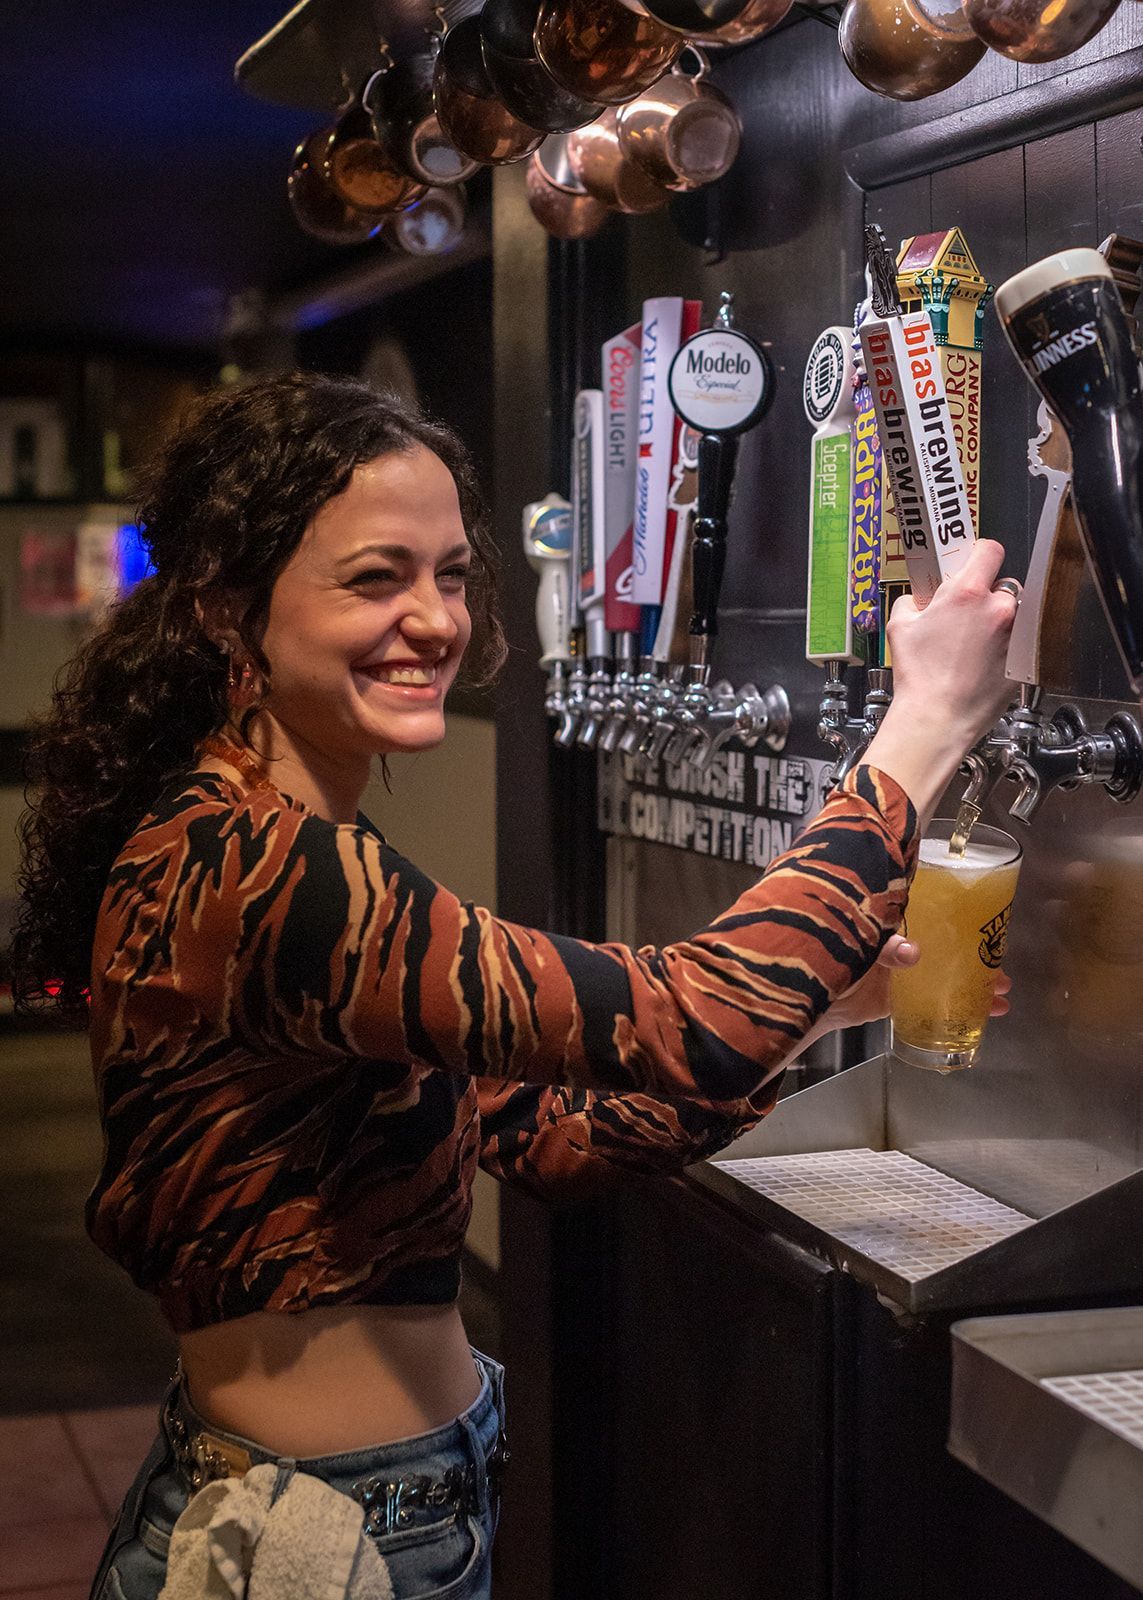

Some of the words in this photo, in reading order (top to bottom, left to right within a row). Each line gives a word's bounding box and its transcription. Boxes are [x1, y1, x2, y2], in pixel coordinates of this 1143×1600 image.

[610, 347, 633, 410] Coors
[640, 318, 658, 435] ULTRA
[686, 349, 751, 375] Modelo
[694, 374, 741, 392] Especial
[830, 335, 844, 380] WORKS
[610, 413, 625, 467] LIGHT
[967, 358, 979, 463] COMPANY
[816, 443, 847, 509] Scepter
[855, 407, 876, 484] IPA
[928, 486, 941, 523] MONTANA
[852, 494, 874, 618] HAZY
[754, 755, 805, 815] THE
[630, 791, 793, 868] COMPETITION
